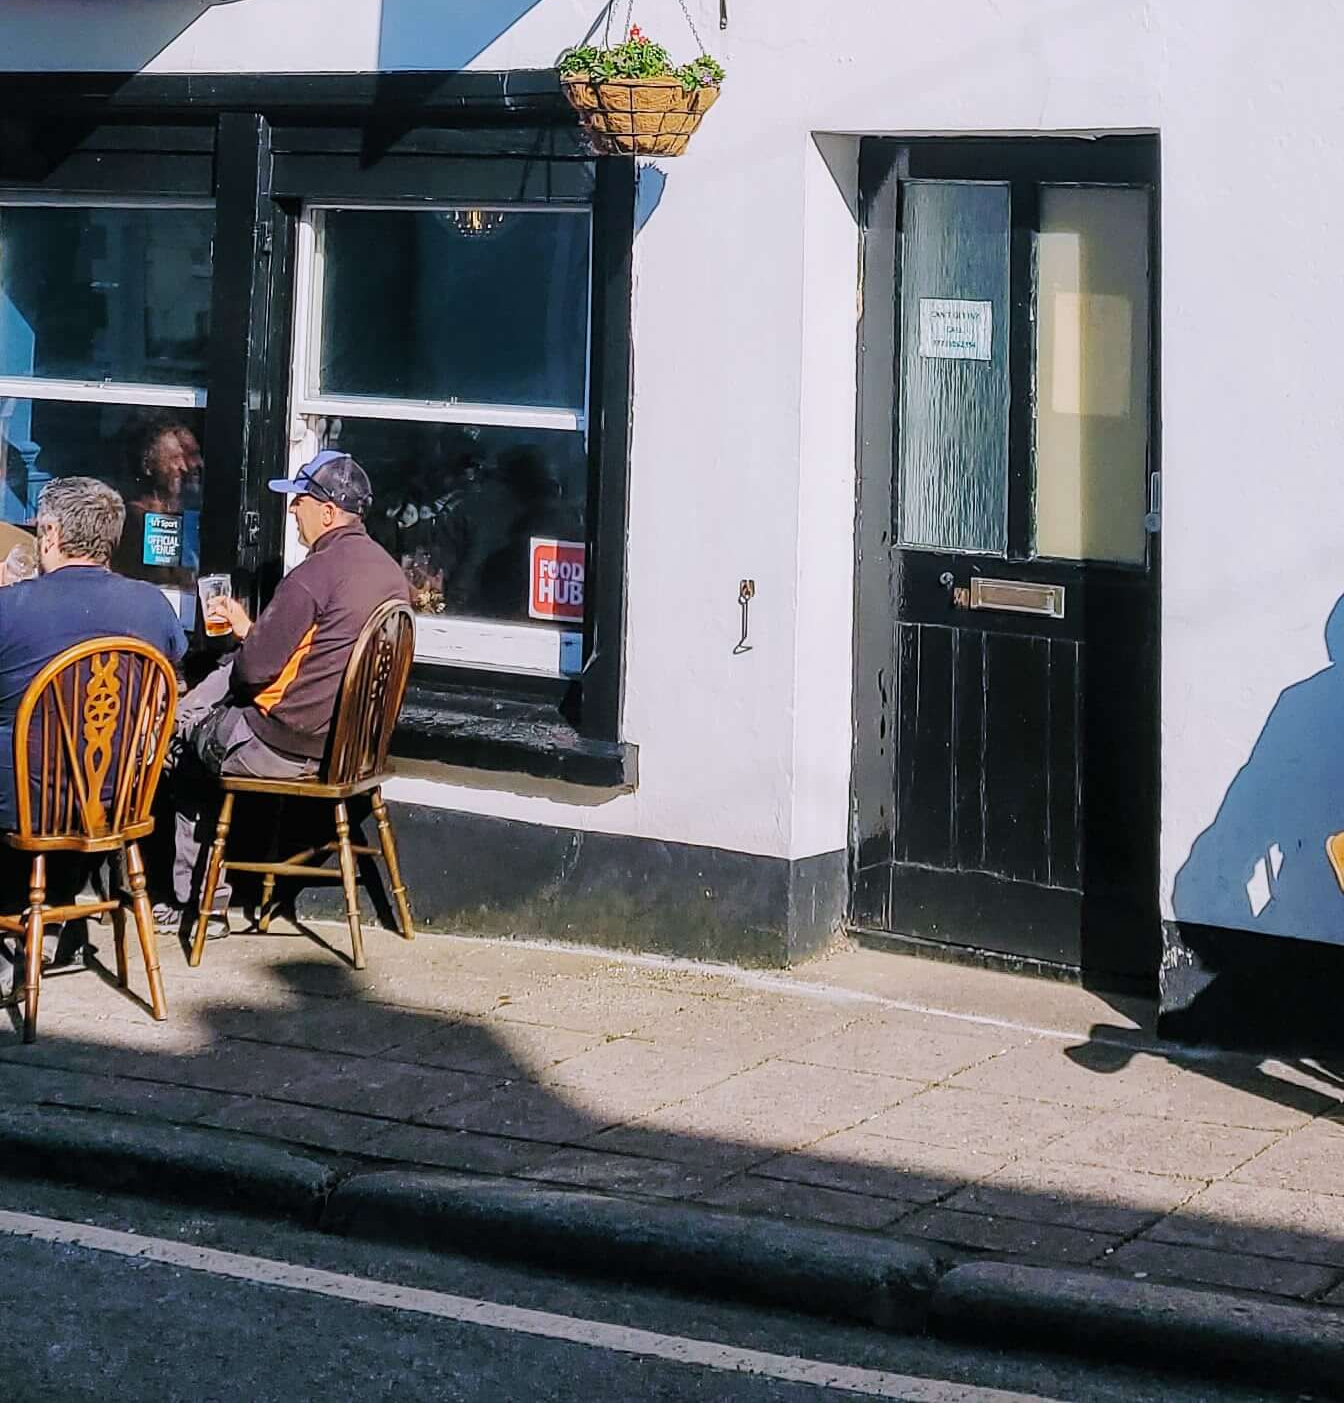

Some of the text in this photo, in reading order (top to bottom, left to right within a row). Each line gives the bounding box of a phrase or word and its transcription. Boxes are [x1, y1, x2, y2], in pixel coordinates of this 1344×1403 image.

[148, 535, 180, 547] OFFICIAL
[151, 545, 176, 556] VENUE
[539, 559, 585, 582] FOOD
[538, 578, 584, 606] HUB
